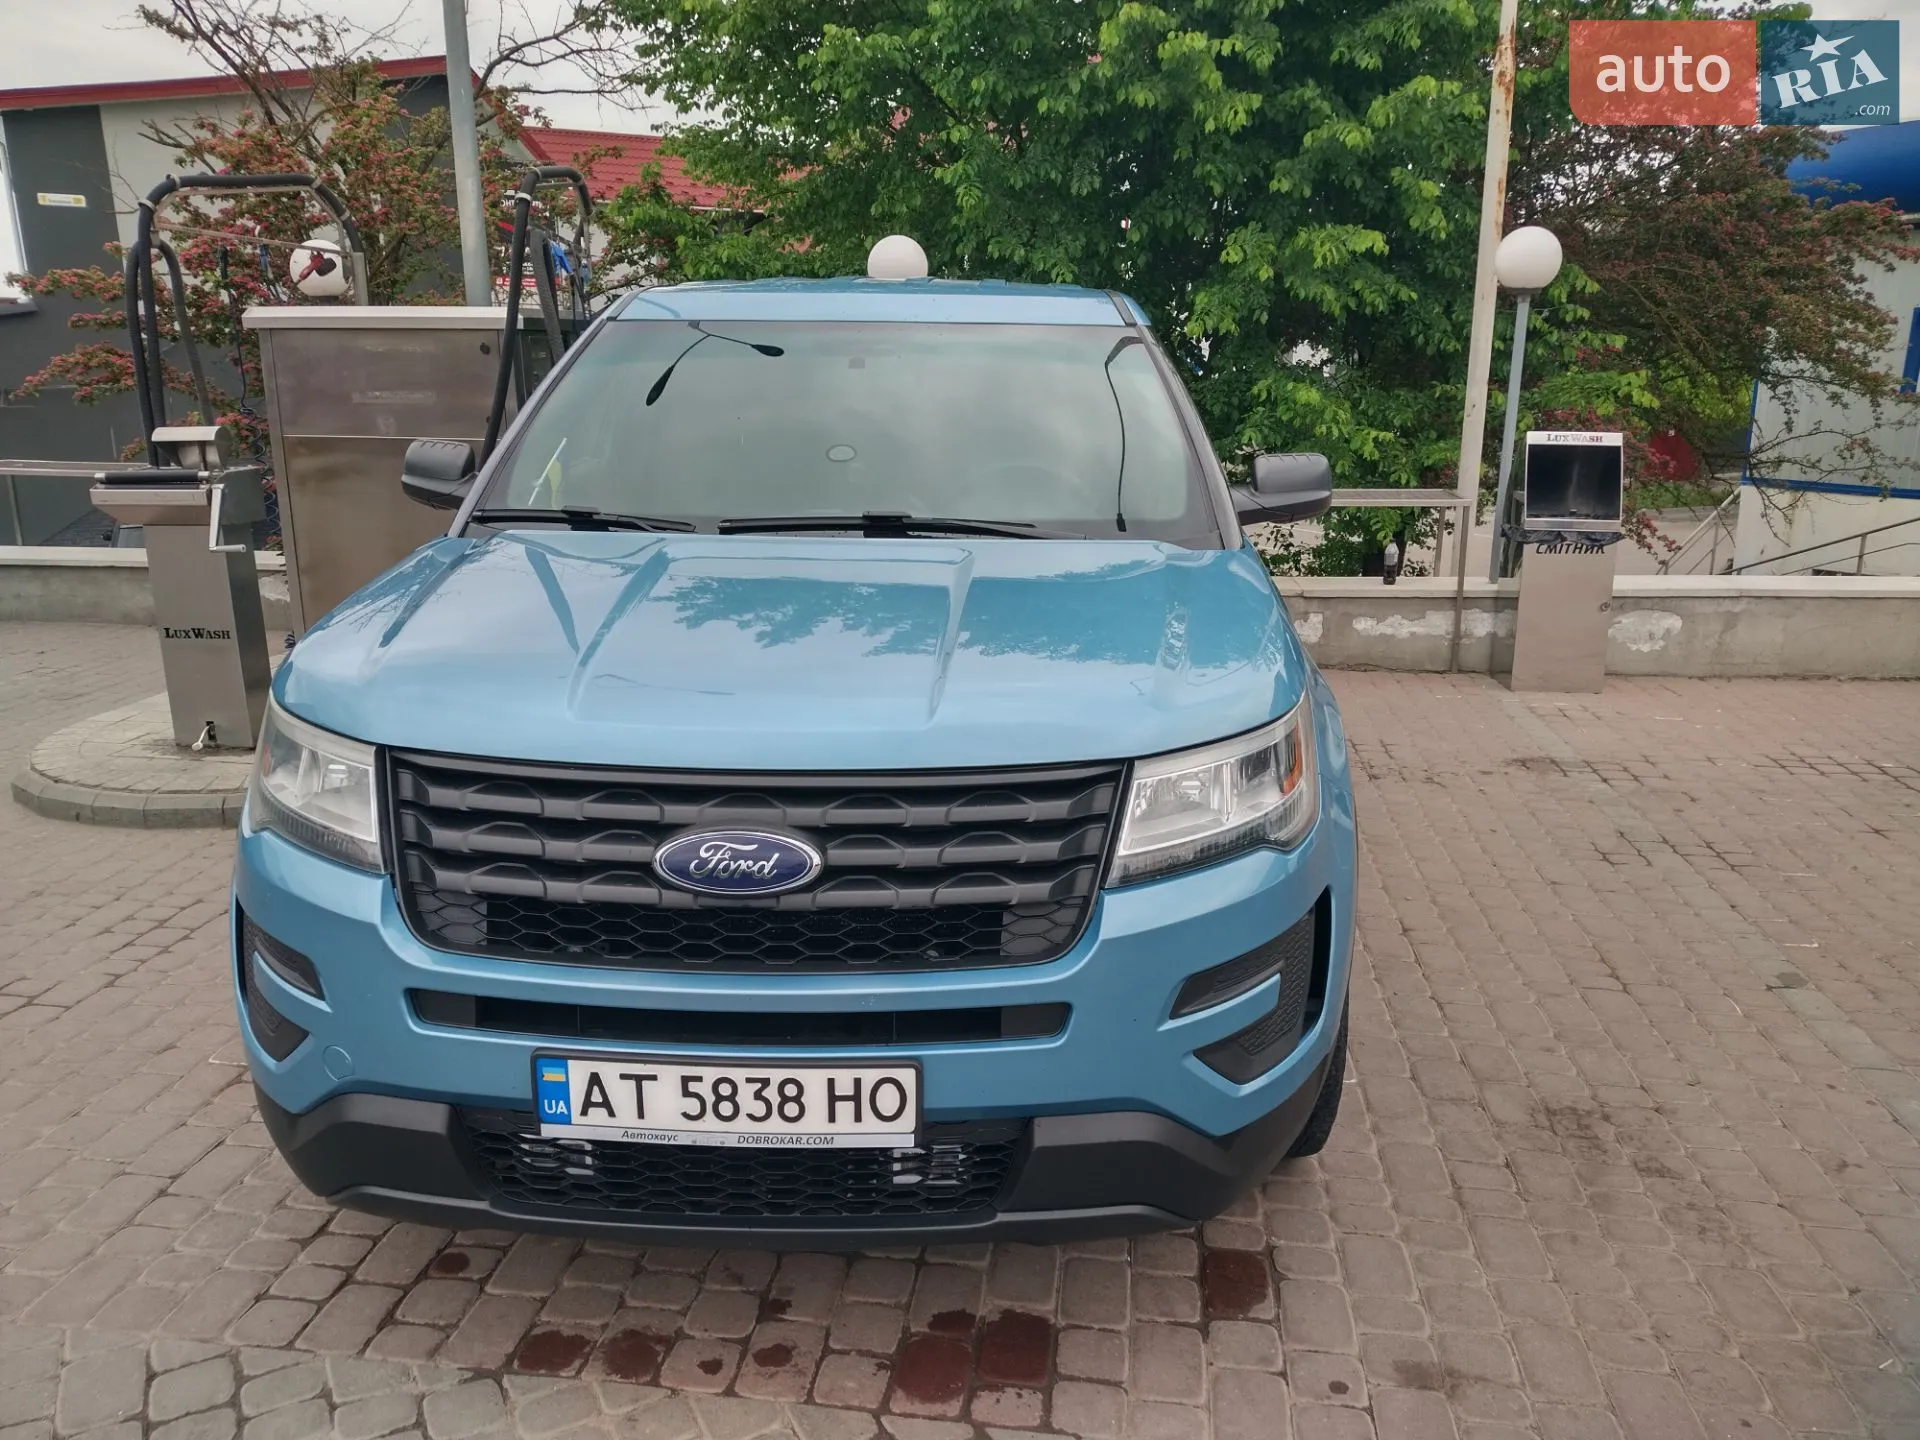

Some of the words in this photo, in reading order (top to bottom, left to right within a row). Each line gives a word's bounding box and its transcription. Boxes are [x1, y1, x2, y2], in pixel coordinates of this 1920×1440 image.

[689, 841, 781, 879] Ford
[579, 1071, 658, 1120] AT
[680, 1074, 806, 1124] 5838
[826, 1075, 908, 1124] HO
[544, 1098, 569, 1116] UA
[620, 1129, 680, 1143] Автохаус
[736, 1134, 835, 1146] DOBROKAR.COM
